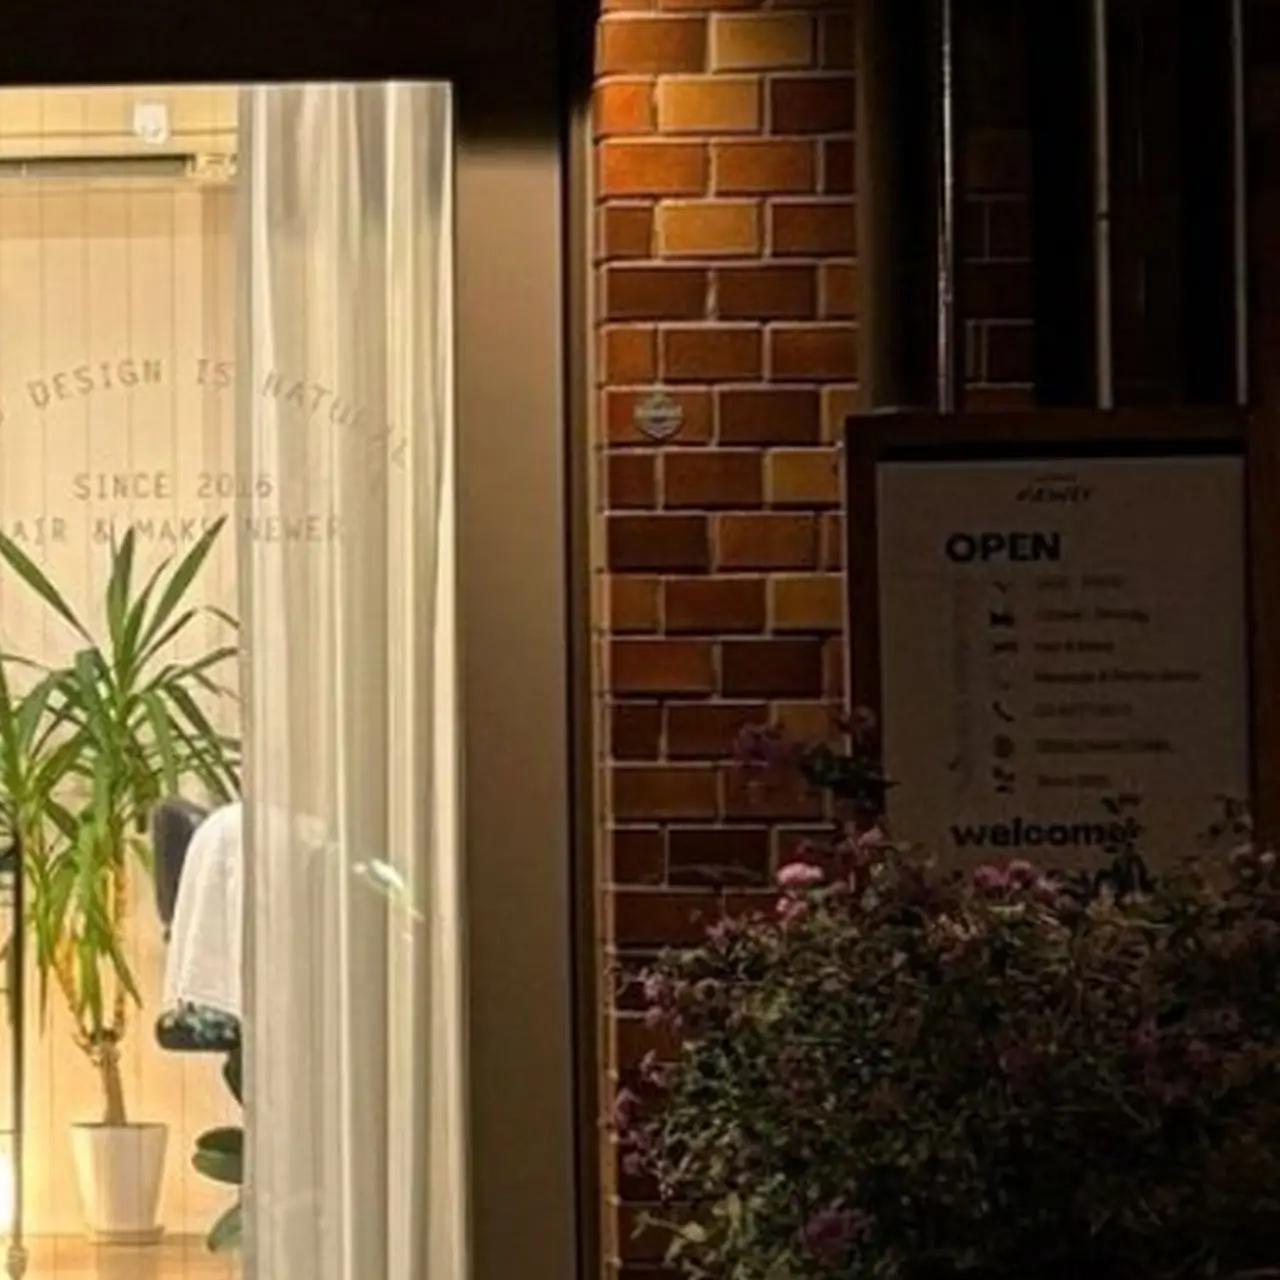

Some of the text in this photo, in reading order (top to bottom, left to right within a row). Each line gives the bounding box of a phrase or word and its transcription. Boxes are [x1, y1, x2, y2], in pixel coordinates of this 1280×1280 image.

[26, 359, 163, 410] DESIGN
[195, 359, 234, 390] IS
[74, 472, 170, 500] SINCE
[946, 533, 1060, 562] OPEN
